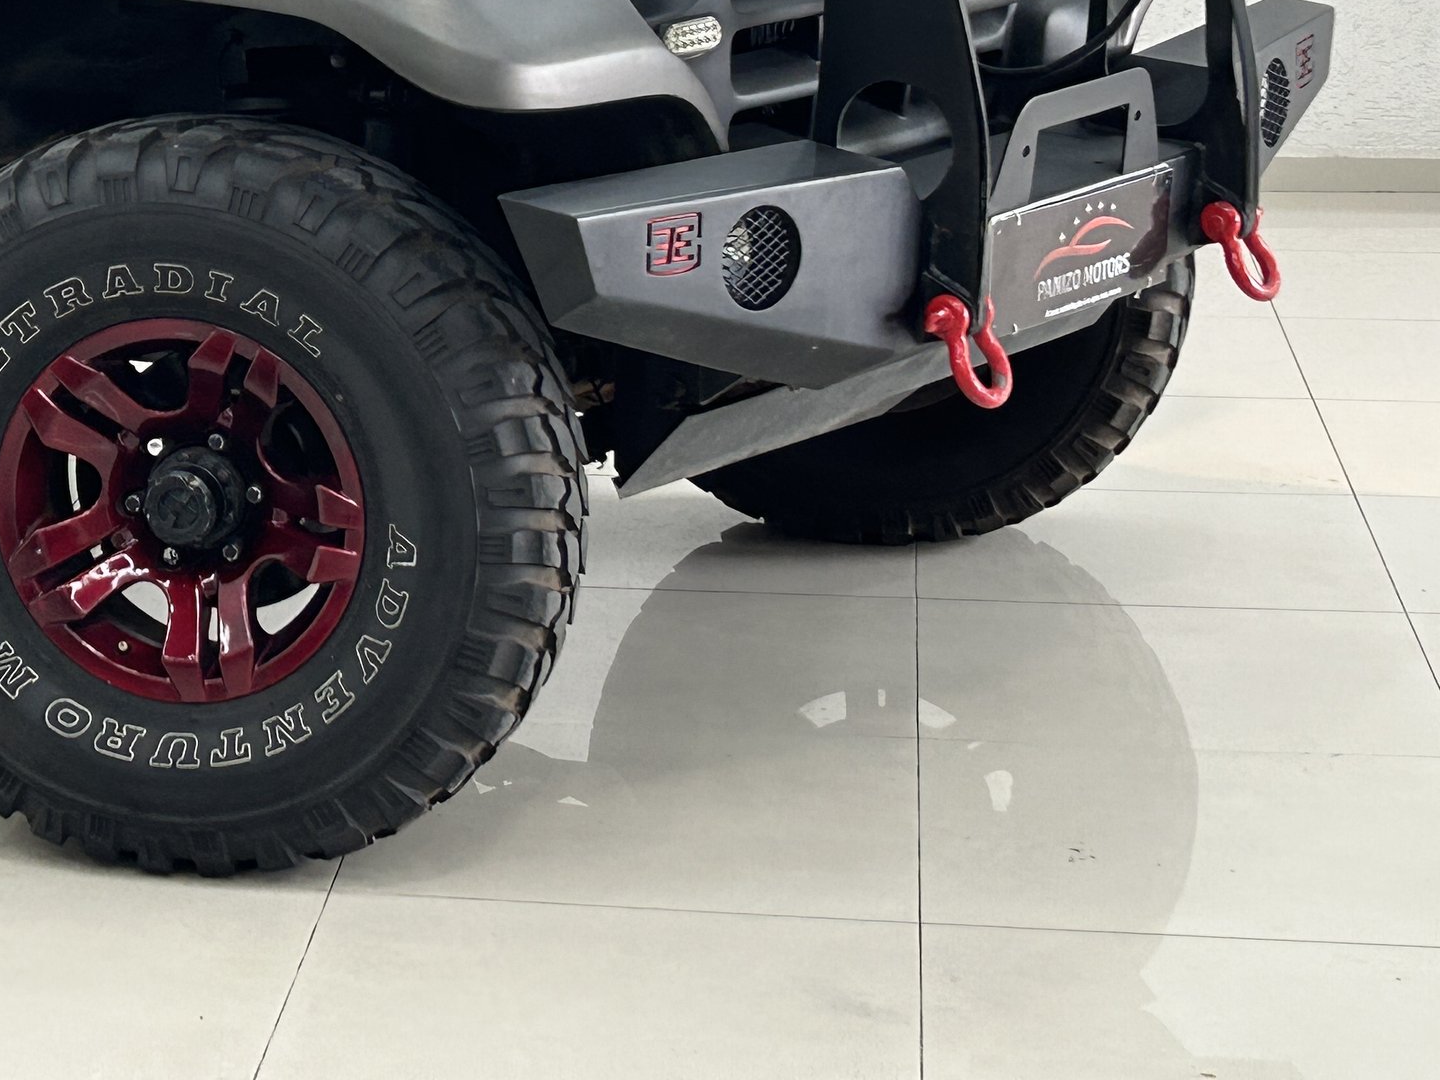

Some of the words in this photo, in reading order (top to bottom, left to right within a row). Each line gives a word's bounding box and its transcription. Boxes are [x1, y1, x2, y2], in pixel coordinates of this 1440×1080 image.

[1037, 269, 1082, 302] PANIZO
[1082, 252, 1131, 287] MOTORS
[45, 523, 418, 768] ADVENTURO
